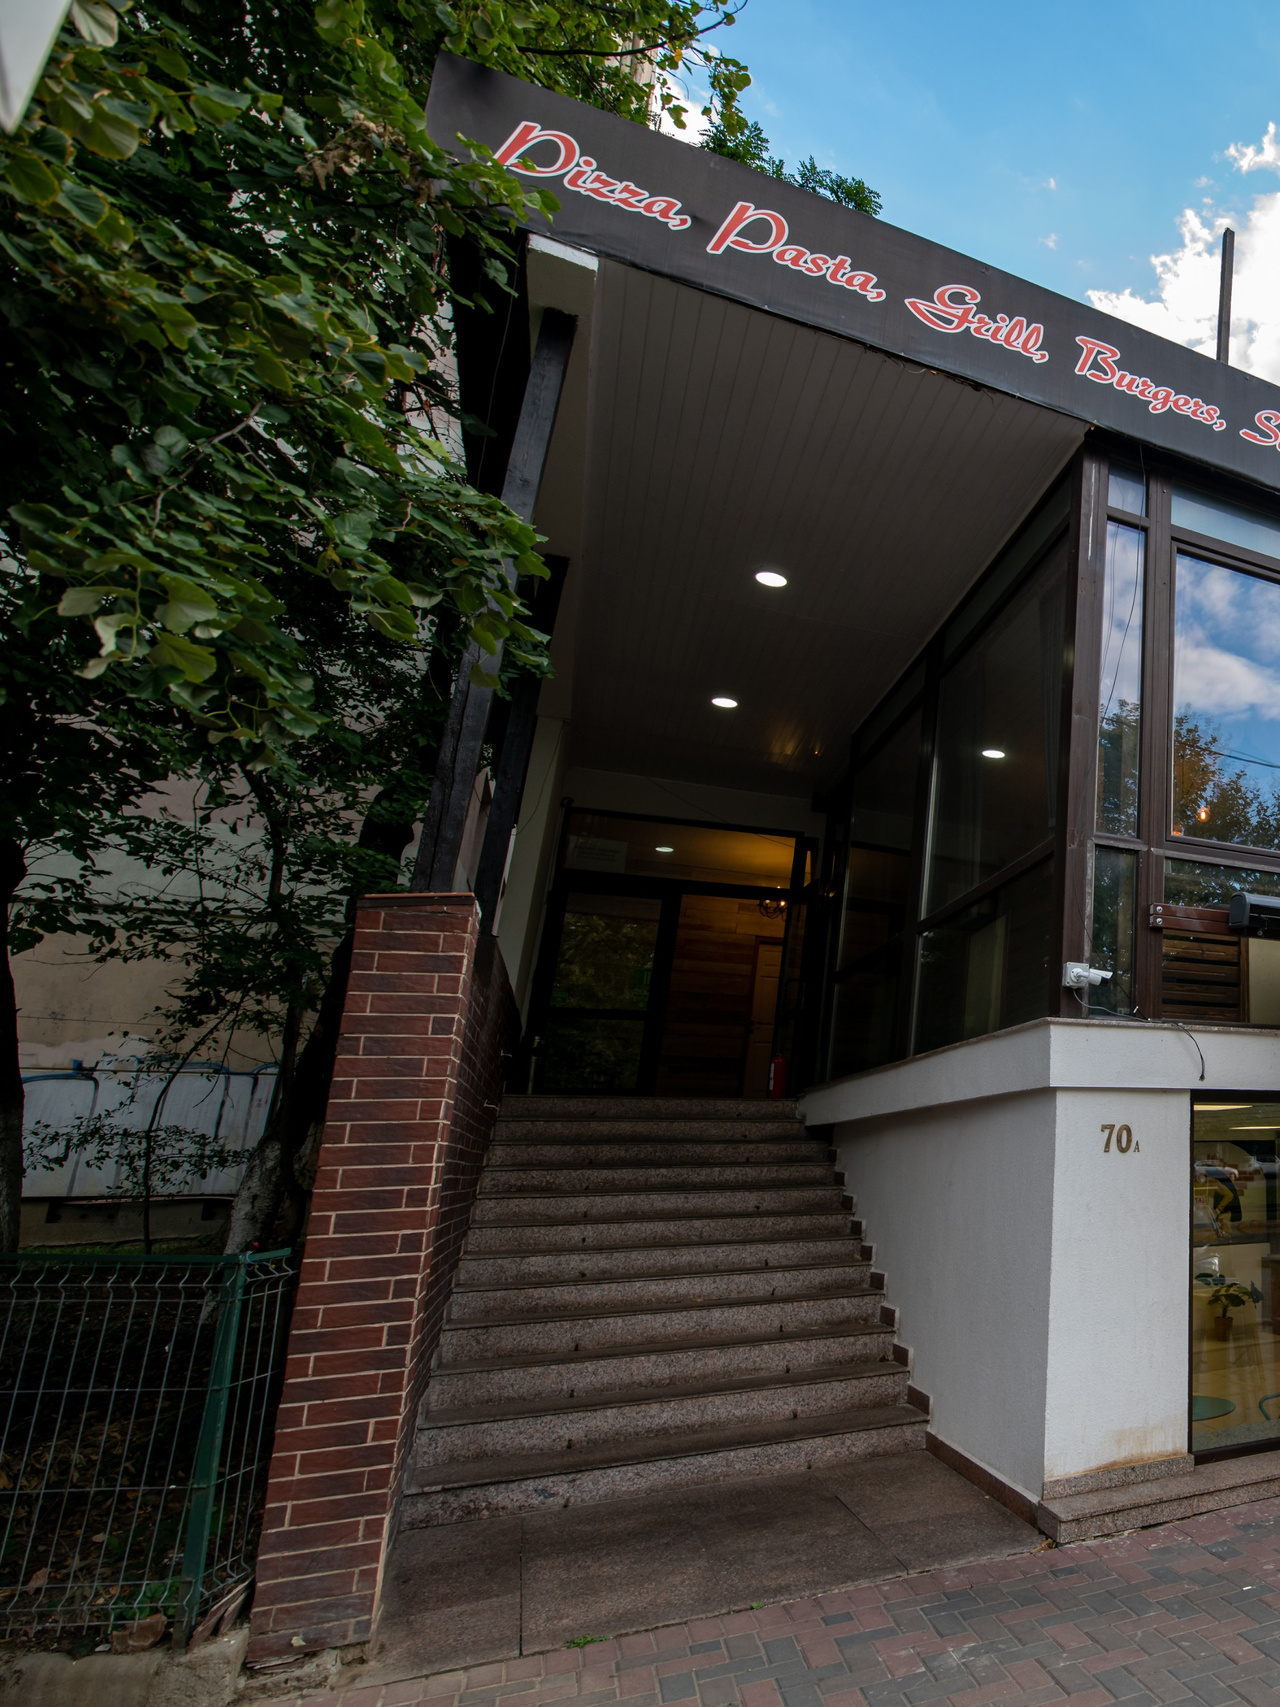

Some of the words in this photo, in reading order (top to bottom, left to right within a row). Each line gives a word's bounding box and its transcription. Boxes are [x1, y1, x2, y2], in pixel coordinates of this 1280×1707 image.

[487, 121, 692, 231] Pizza,
[706, 201, 887, 302] Pasta,
[904, 284, 1050, 363] Grill,
[1075, 335, 1227, 431] Burgers,
